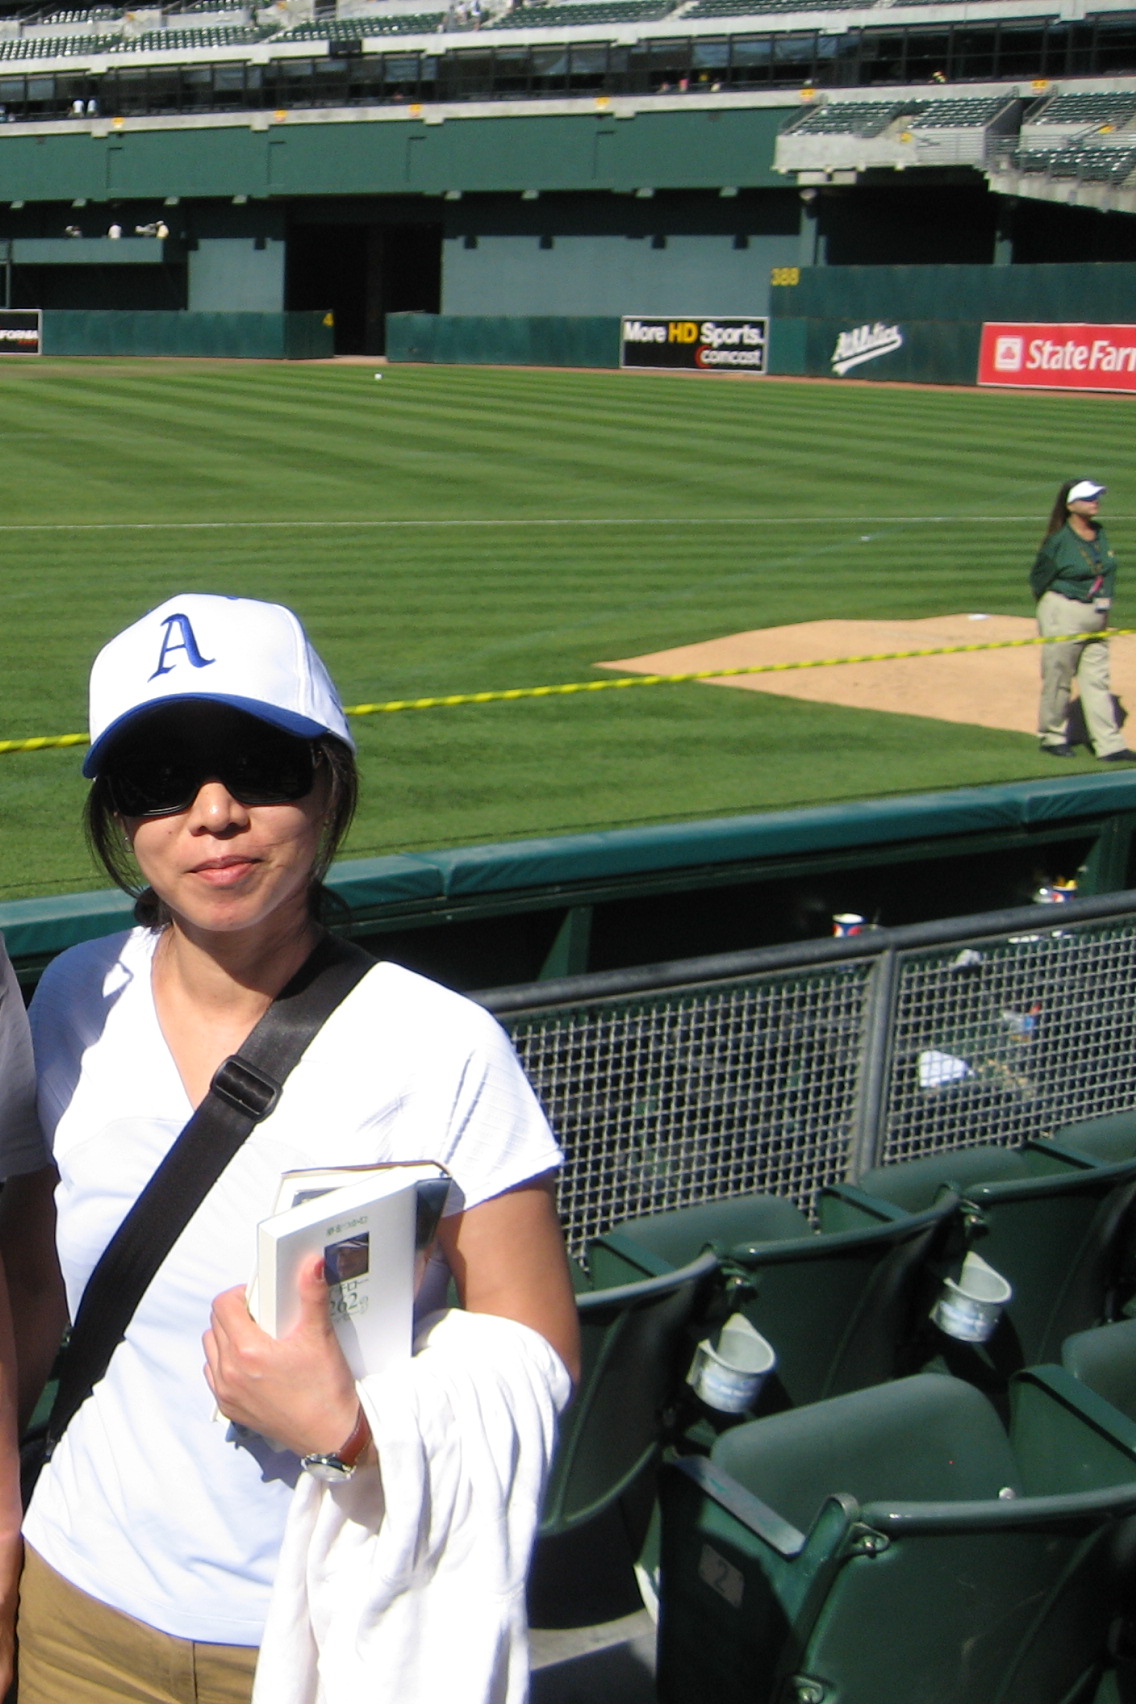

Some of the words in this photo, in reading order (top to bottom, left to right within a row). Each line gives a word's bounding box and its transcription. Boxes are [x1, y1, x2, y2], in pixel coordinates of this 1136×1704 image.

[624, 322, 667, 342] More
[668, 322, 698, 343] HD
[147, 613, 216, 683] A
